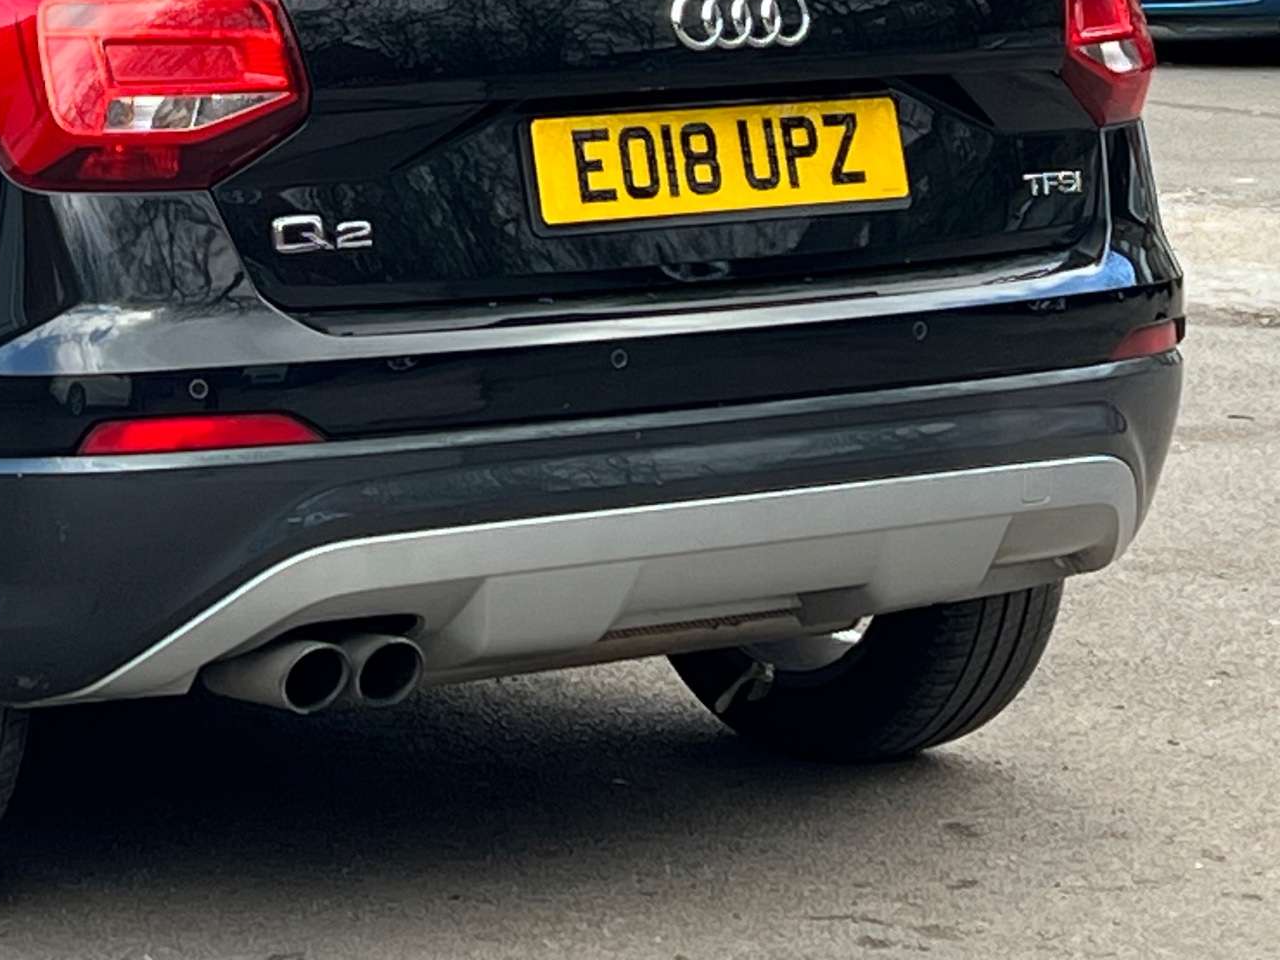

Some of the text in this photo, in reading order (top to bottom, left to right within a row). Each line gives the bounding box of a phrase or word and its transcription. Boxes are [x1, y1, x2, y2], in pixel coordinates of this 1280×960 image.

[571, 113, 866, 204] EO18 UPZ
[1023, 171, 1082, 196] TFSI
[272, 214, 373, 254] Q2
